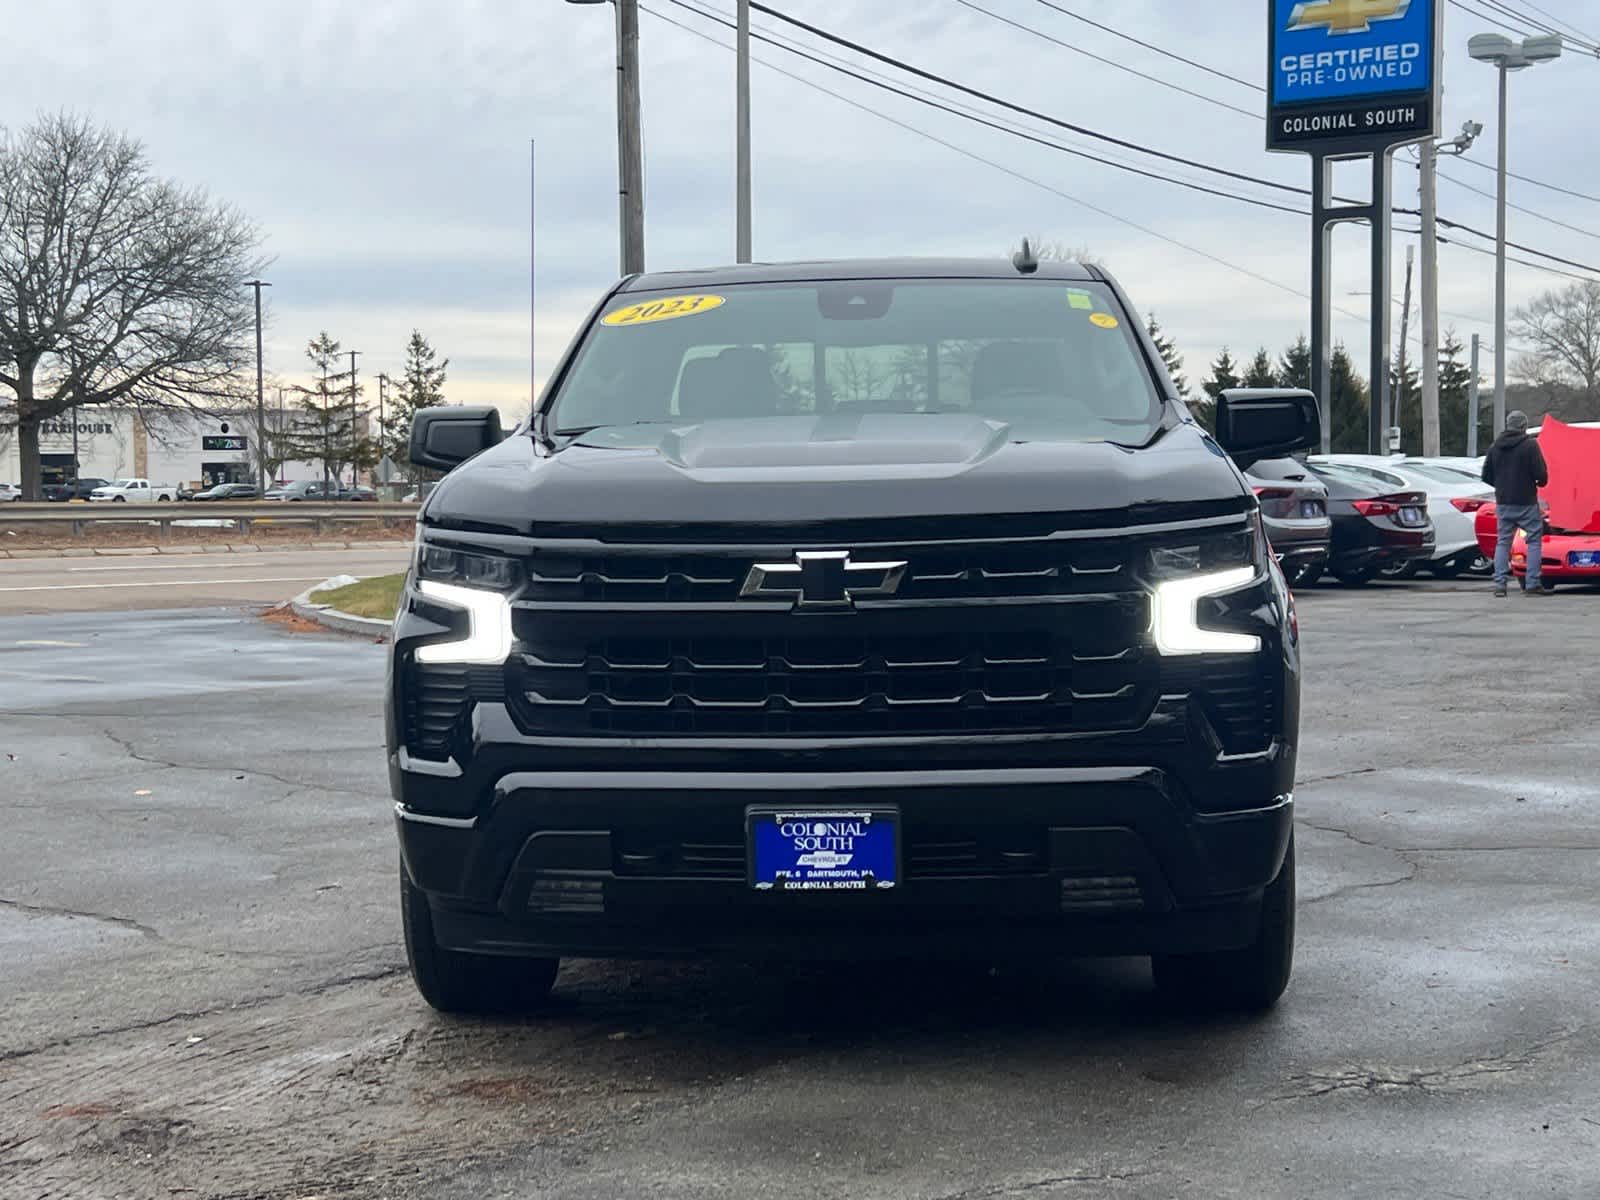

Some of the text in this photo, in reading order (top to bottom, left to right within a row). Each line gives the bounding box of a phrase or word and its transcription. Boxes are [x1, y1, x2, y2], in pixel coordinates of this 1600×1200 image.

[1280, 43, 1419, 71] CERTIFIED
[1287, 61, 1412, 87] PRE-OWNED
[1283, 108, 1415, 133] COLONIAL SOUTH
[619, 297, 704, 323] 2023
[780, 823, 867, 837] COLONIAL
[794, 837, 853, 850] SOUTH
[784, 880, 866, 889] COLONIAL SOUTH
